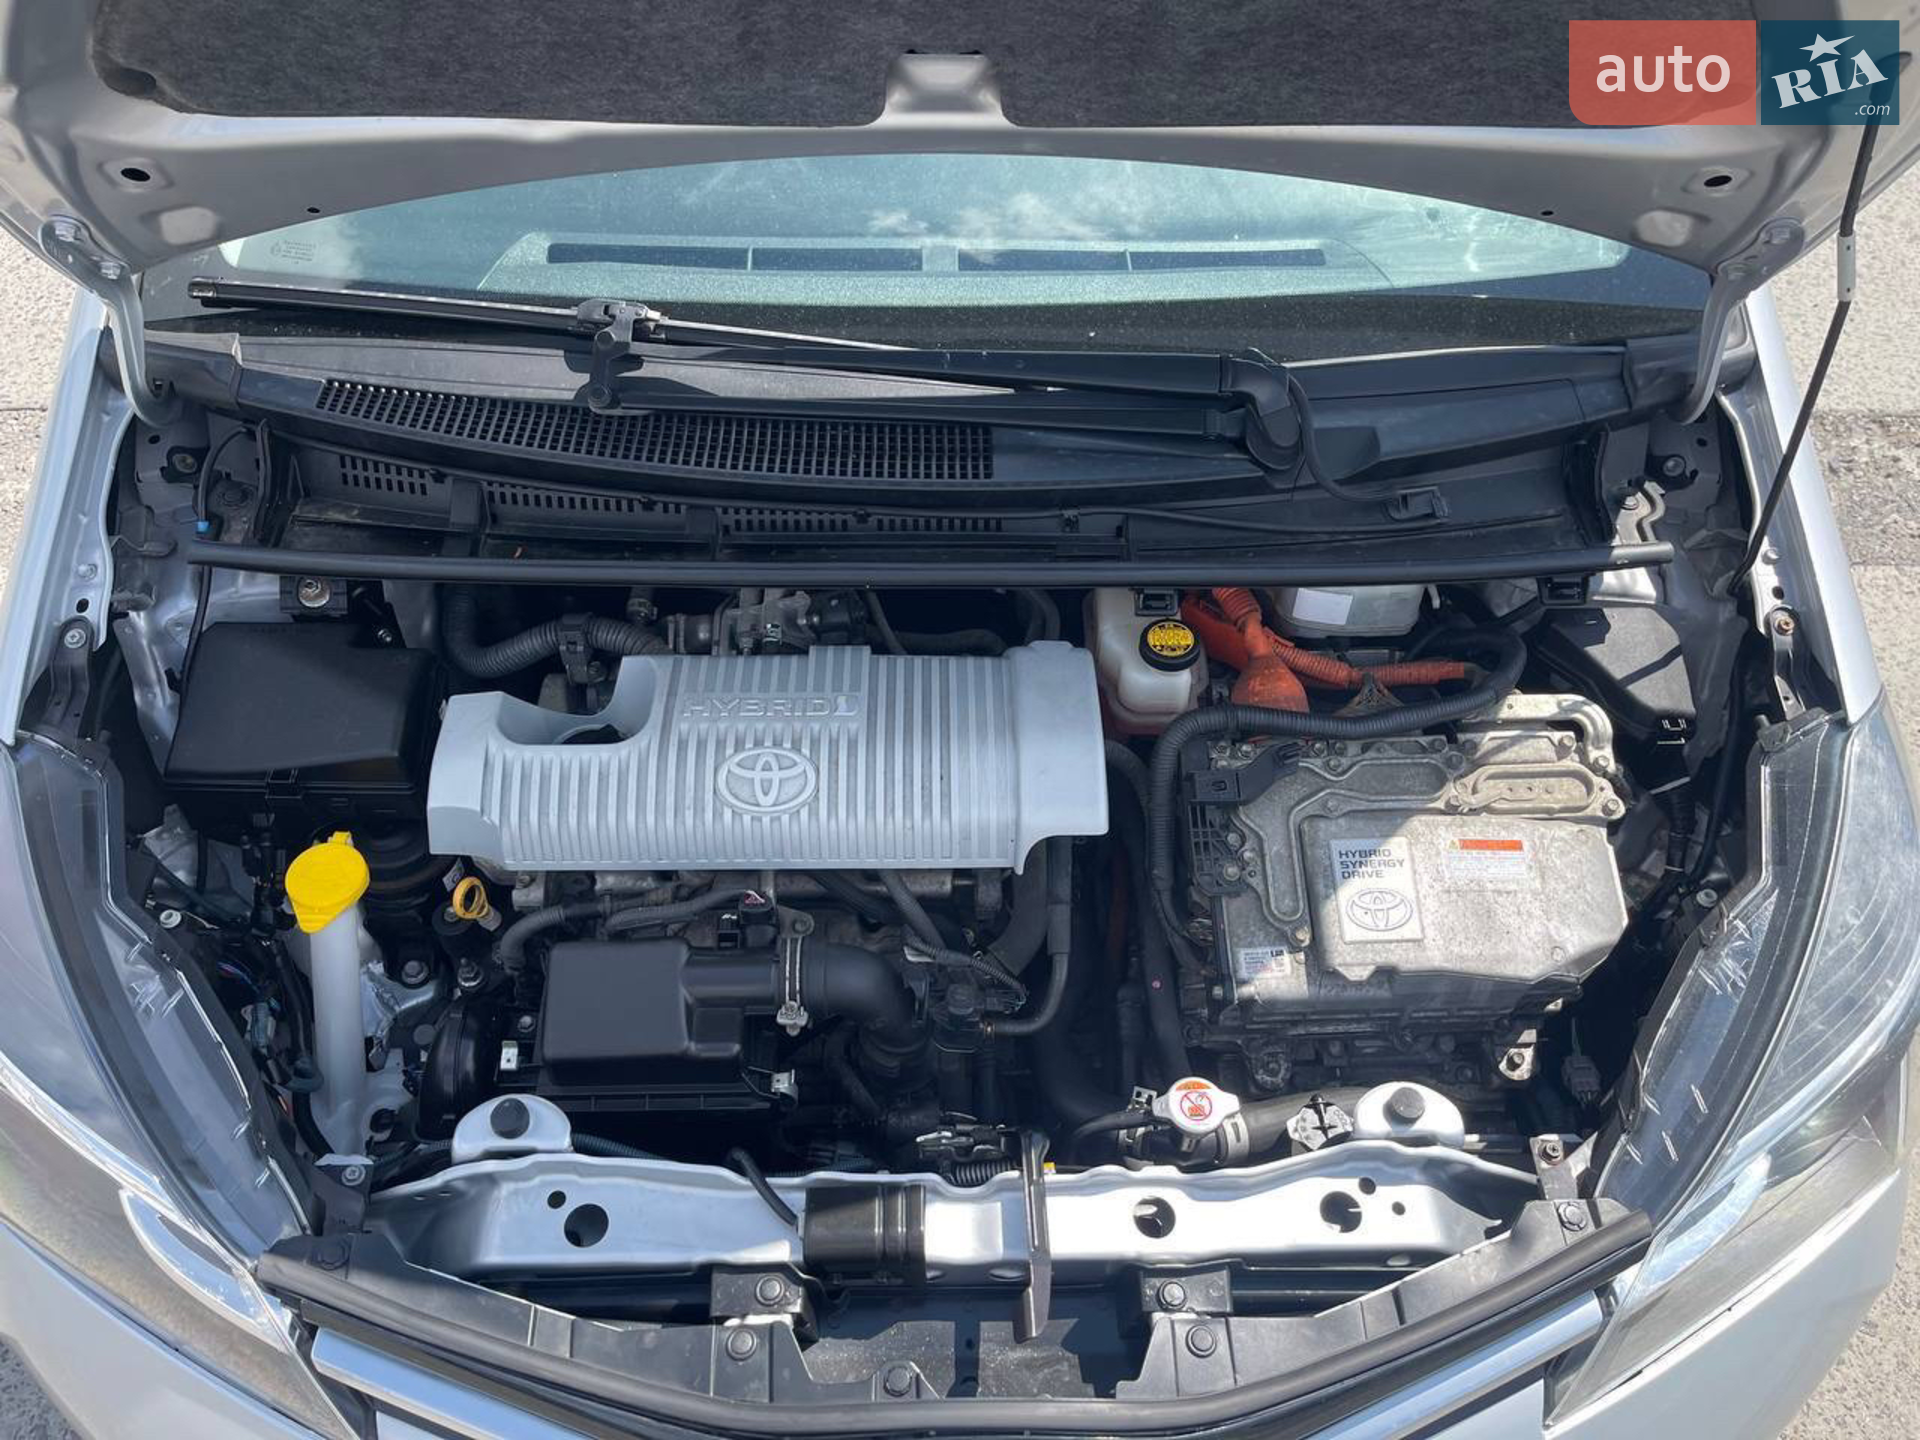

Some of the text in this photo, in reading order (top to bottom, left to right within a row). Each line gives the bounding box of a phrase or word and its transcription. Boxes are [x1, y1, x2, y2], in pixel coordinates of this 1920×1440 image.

[683, 695, 830, 718] HYBRID
[1338, 848, 1392, 859] HYBRID
[1339, 858, 1405, 868] SYNERGY
[1341, 869, 1385, 880] DRIVE
